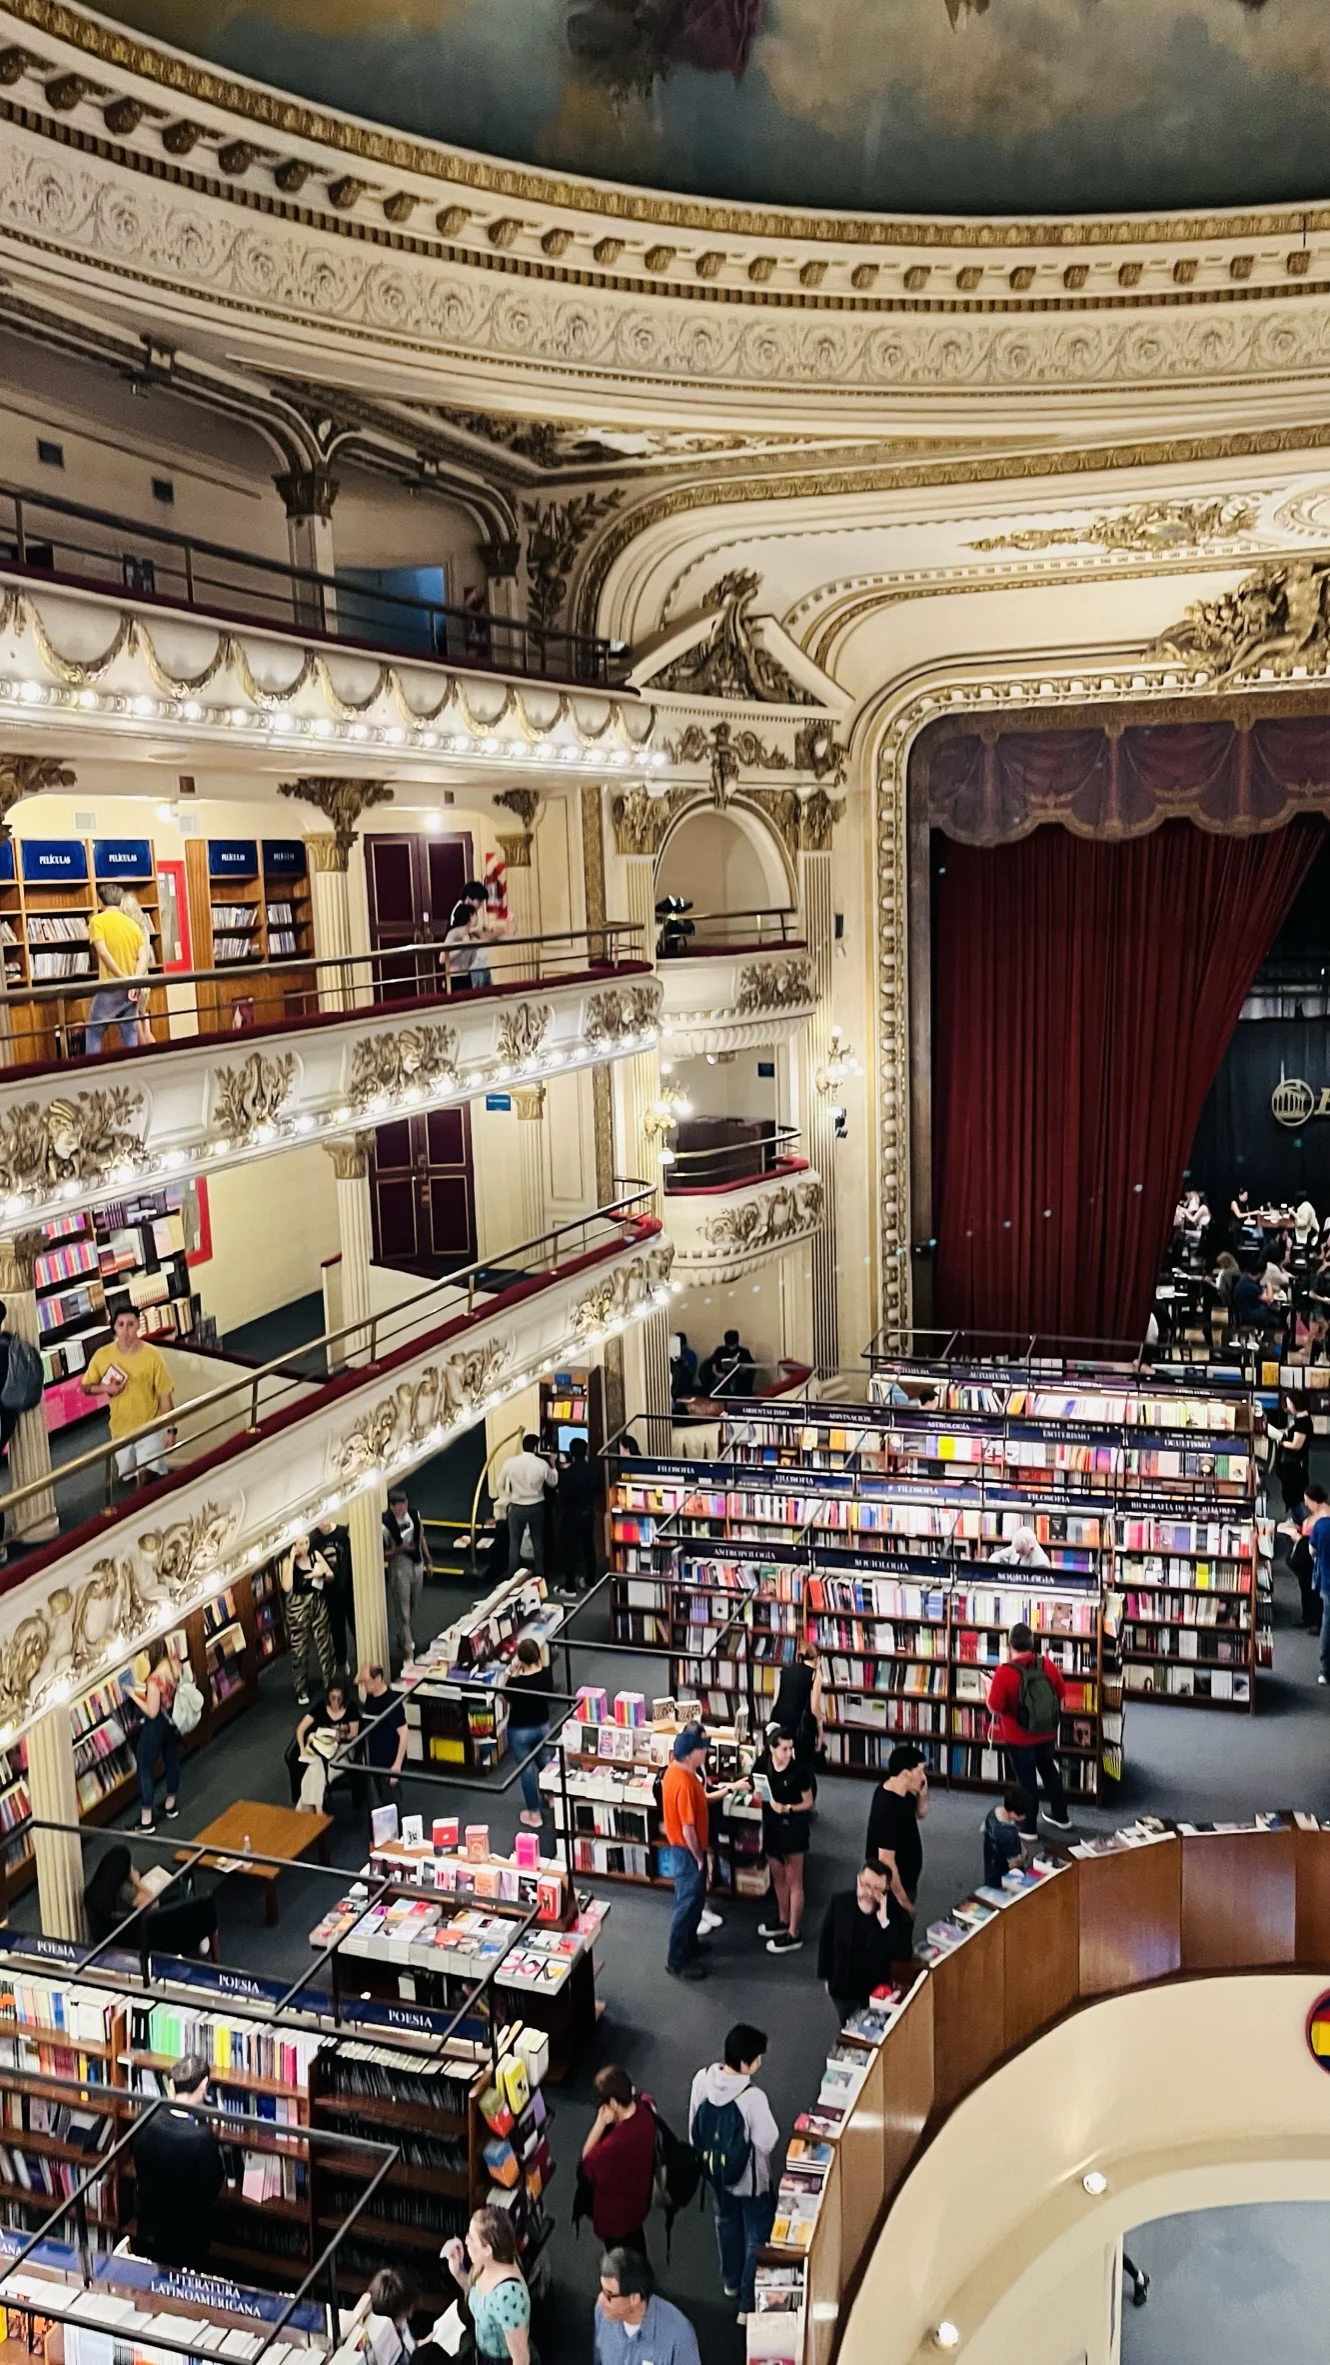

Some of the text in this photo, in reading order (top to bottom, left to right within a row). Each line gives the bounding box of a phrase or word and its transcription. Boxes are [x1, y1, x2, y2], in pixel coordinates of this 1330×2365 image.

[39, 853, 71, 865] PELÍCULAS
[108, 853, 138, 863] PELÍCULAS
[926, 1420, 970, 1431] ASTROLOGÍA
[1164, 1438, 1211, 1449] OCULTISMO
[169, 2271, 241, 2299] LITERATURA
[151, 2281, 261, 2318] LATINOAMERICANA
